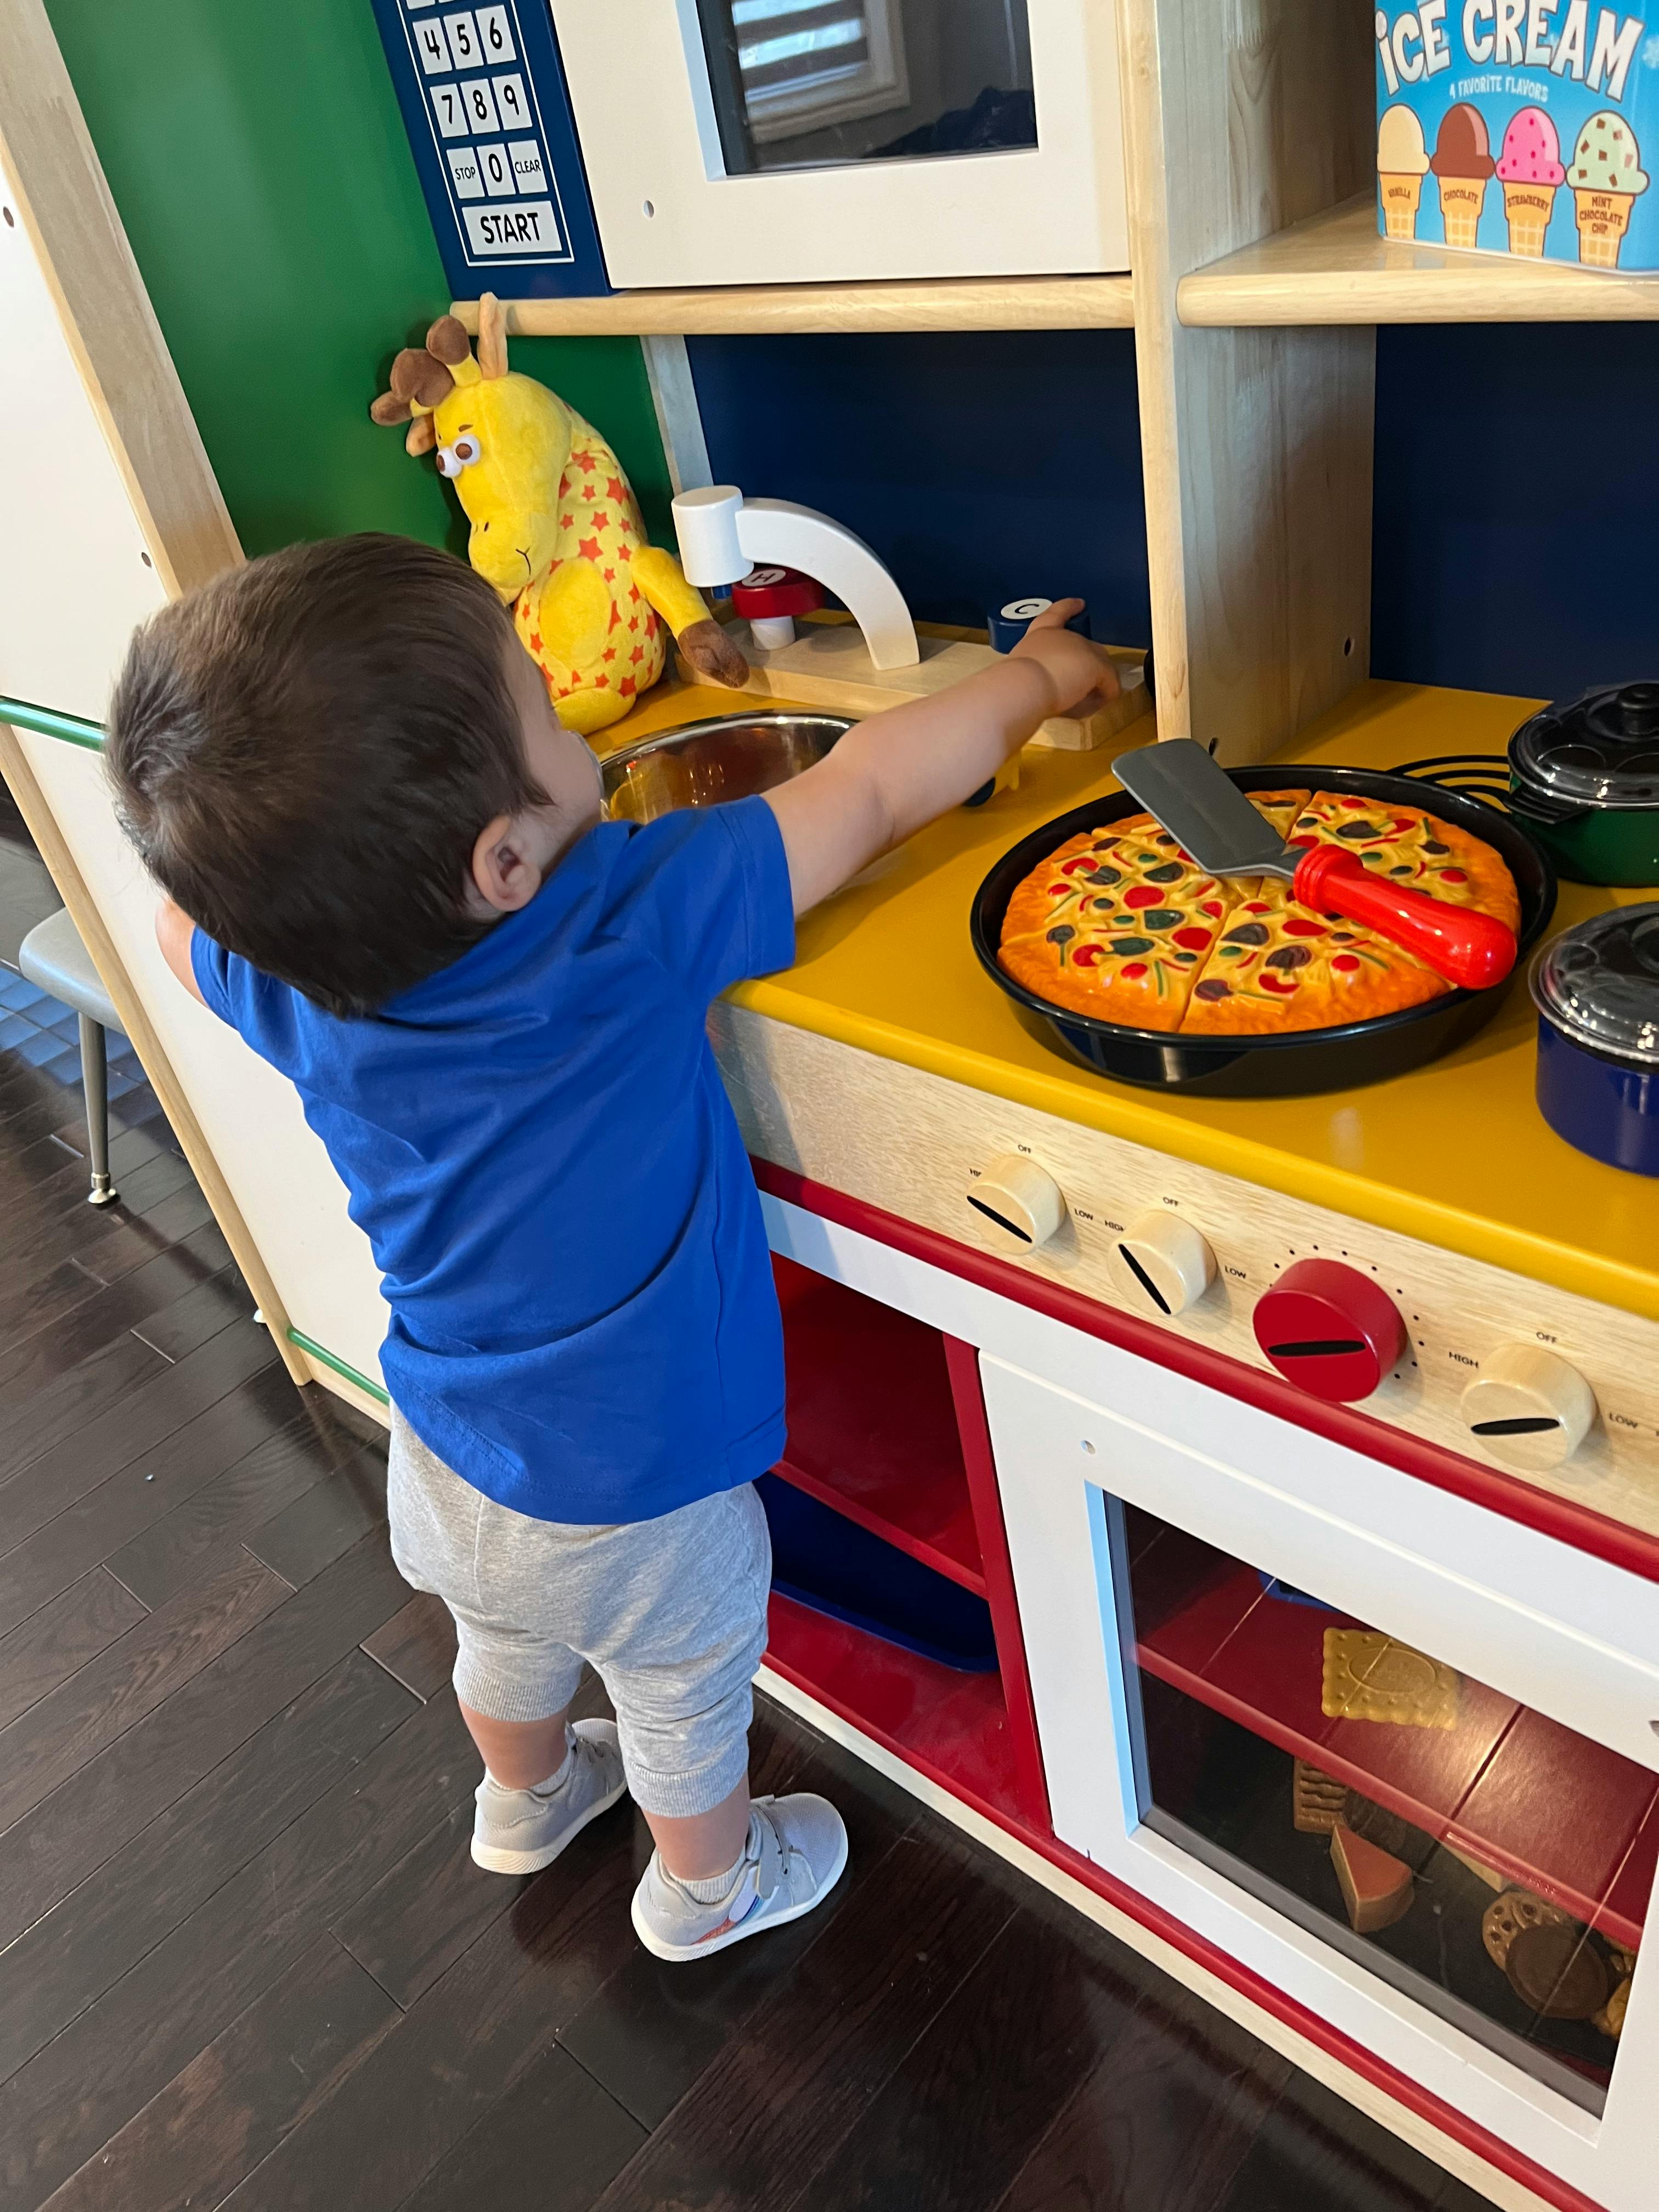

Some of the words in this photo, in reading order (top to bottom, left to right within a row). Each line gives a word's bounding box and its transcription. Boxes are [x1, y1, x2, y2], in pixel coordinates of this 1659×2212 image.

[424, 30, 440, 60] 4
[456, 24, 470, 55] 5
[489, 17, 503, 49] 6
[1463, 0, 1645, 103] CREAM
[1449, 83, 1455, 100] 4
[1505, 76, 1548, 103] FLAVORS
[441, 94, 453, 125] 7
[473, 89, 487, 120] 8
[504, 84, 520, 115] 9
[455, 166, 476, 180] STOP
[488, 153, 503, 183] 0
[515, 159, 541, 174] CLEAR
[1444, 188, 1479, 205] CHOCOLATE
[1507, 194, 1550, 212] STRAWBERRY
[1579, 209, 1623, 226] CHOCOLATE
[480, 212, 540, 244] START
[751, 573, 776, 583] H
[1014, 603, 1040, 614] C
[1018, 1144, 1031, 1153] OFF
[1163, 1197, 1178, 1207] OFF
[1074, 1208, 1093, 1221] LOW
[1224, 1265, 1246, 1279] LOW
[1536, 1331, 1558, 1344] OFF
[1448, 1351, 1479, 1369] HIGH
[1609, 1412, 1638, 1429] LOW
